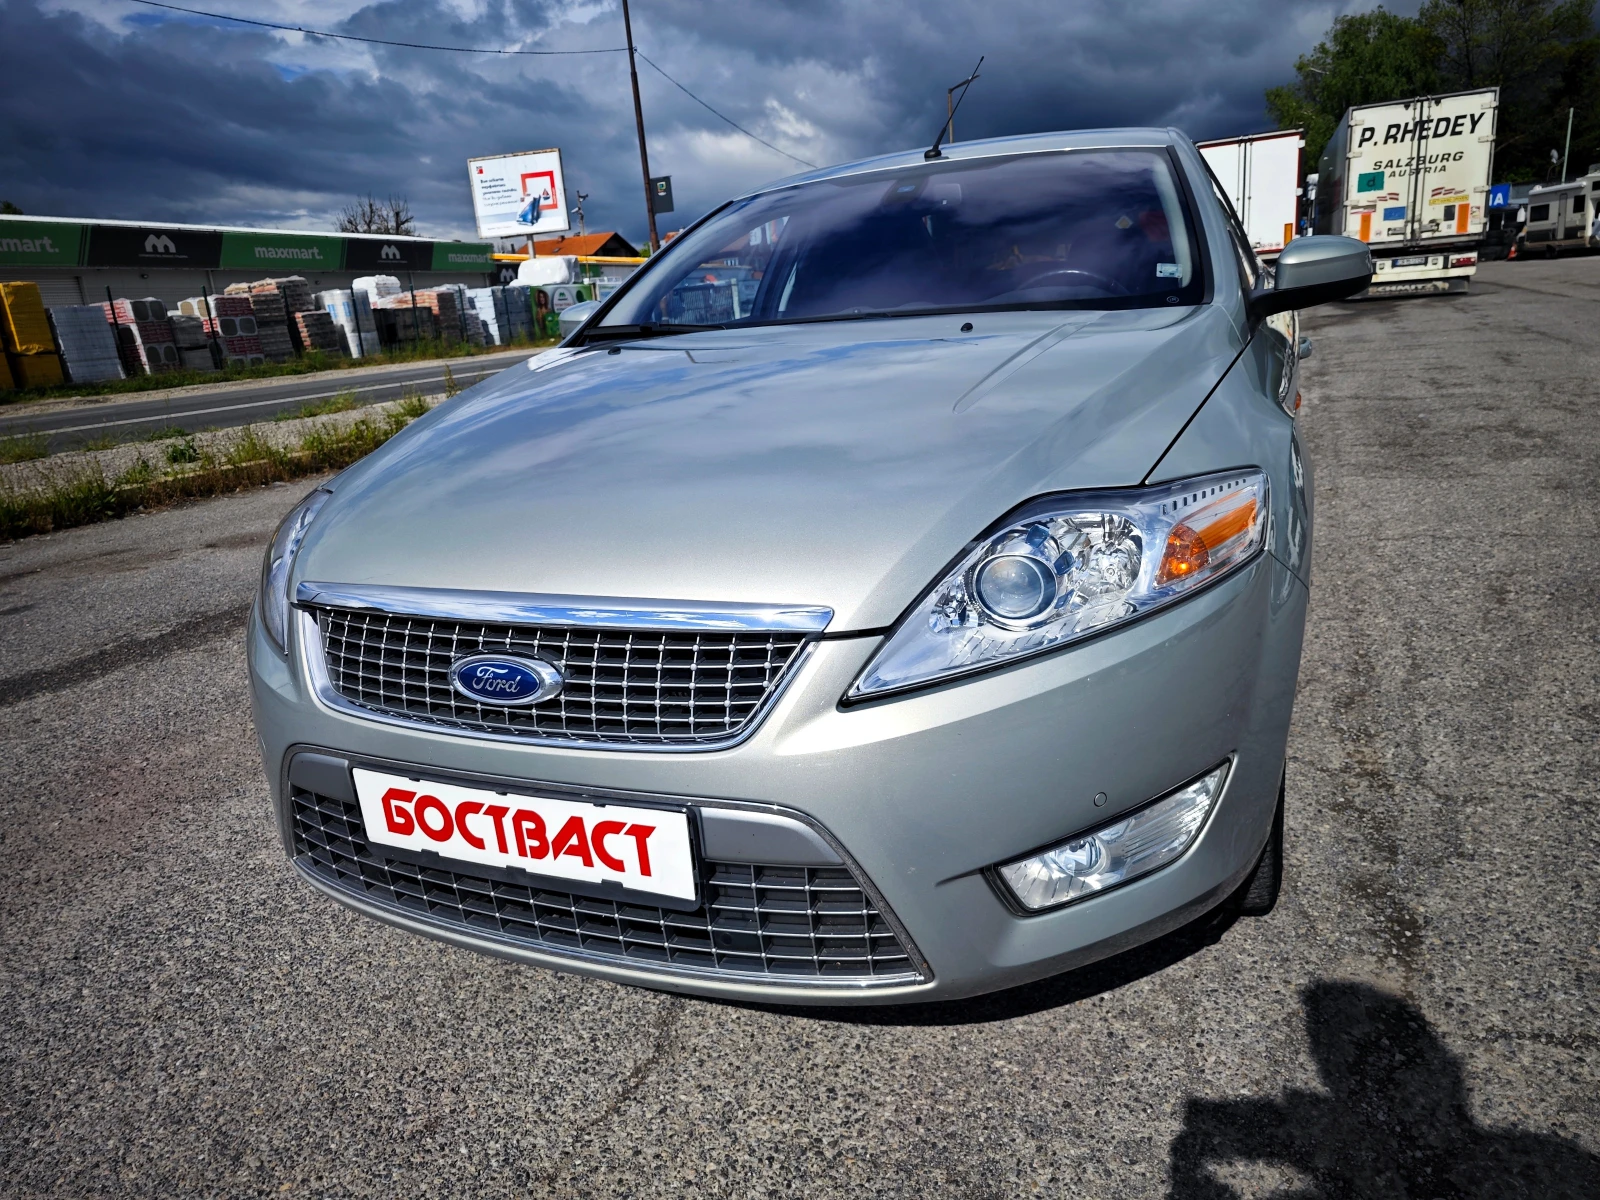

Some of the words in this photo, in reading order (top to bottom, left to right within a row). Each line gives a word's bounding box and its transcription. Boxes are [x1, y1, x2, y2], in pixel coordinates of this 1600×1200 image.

[1383, 112, 1486, 145] RHEDEY
[1373, 151, 1464, 171] SALZBURG
[1388, 165, 1447, 178] AUSTRIA
[0, 236, 60, 253] mart.
[254, 246, 324, 260] maxxmart.
[472, 666, 522, 693] Ford
